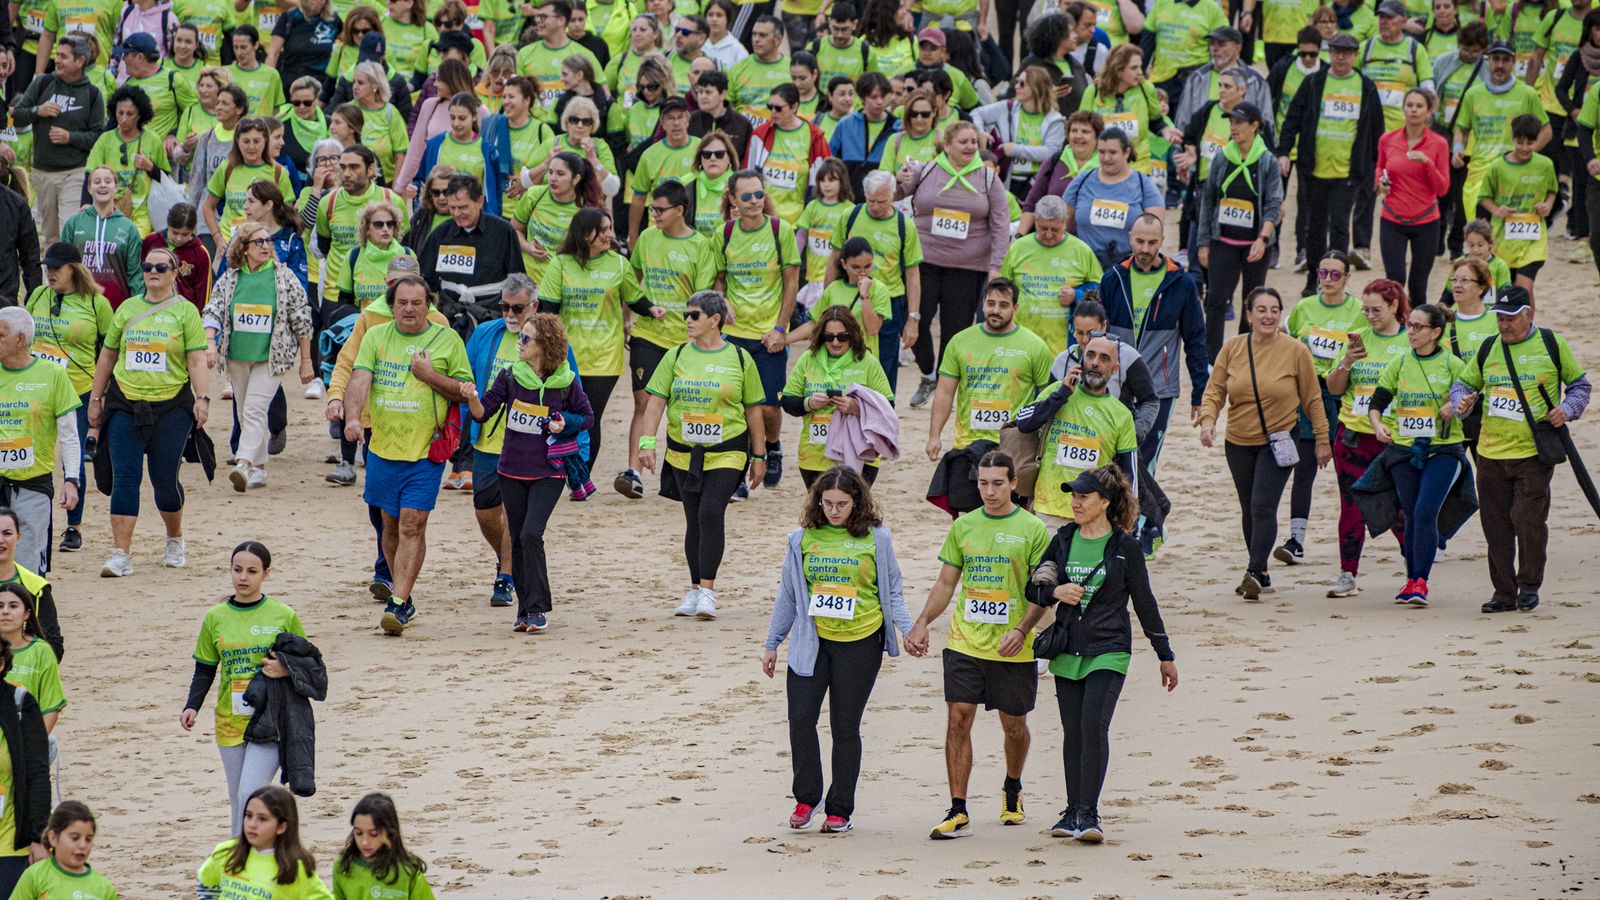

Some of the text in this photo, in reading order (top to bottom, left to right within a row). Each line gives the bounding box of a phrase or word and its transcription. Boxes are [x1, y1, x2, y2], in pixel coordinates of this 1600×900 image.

[1332, 102, 1355, 113] 583
[766, 168, 796, 181] 4214
[1094, 208, 1125, 221] 4844
[1224, 207, 1253, 221] 4674
[936, 217, 968, 232] 4843
[1510, 222, 1540, 234] 2272
[442, 254, 473, 268] 4888
[736, 260, 768, 269] marcha
[1032, 274, 1067, 283] marcha
[572, 286, 605, 295] marcha
[1022, 282, 1049, 290] contra
[238, 313, 271, 327] 4677
[136, 328, 169, 339] marcha
[1312, 335, 1344, 352] 4441
[135, 351, 161, 365] 802
[965, 365, 1009, 375] En marcha
[684, 378, 721, 389] marcha
[672, 387, 700, 396] contra
[1409, 391, 1443, 401] marcha
[1492, 396, 1526, 414] 4292
[511, 410, 544, 428] 4678
[975, 409, 1010, 423] 4293
[686, 422, 722, 436] 3082
[1062, 419, 1098, 437] marcha
[1402, 417, 1434, 430] 4294
[1062, 444, 1098, 463] 1885
[808, 555, 860, 567] En marcha
[975, 553, 1011, 565] marcha
[807, 564, 838, 574] contra
[818, 572, 852, 584] cáncer
[972, 572, 1005, 583] cáncer
[815, 594, 855, 613] 3481
[970, 599, 1008, 617] 3482
[233, 646, 269, 656] marcha
[231, 881, 273, 900] marcha
